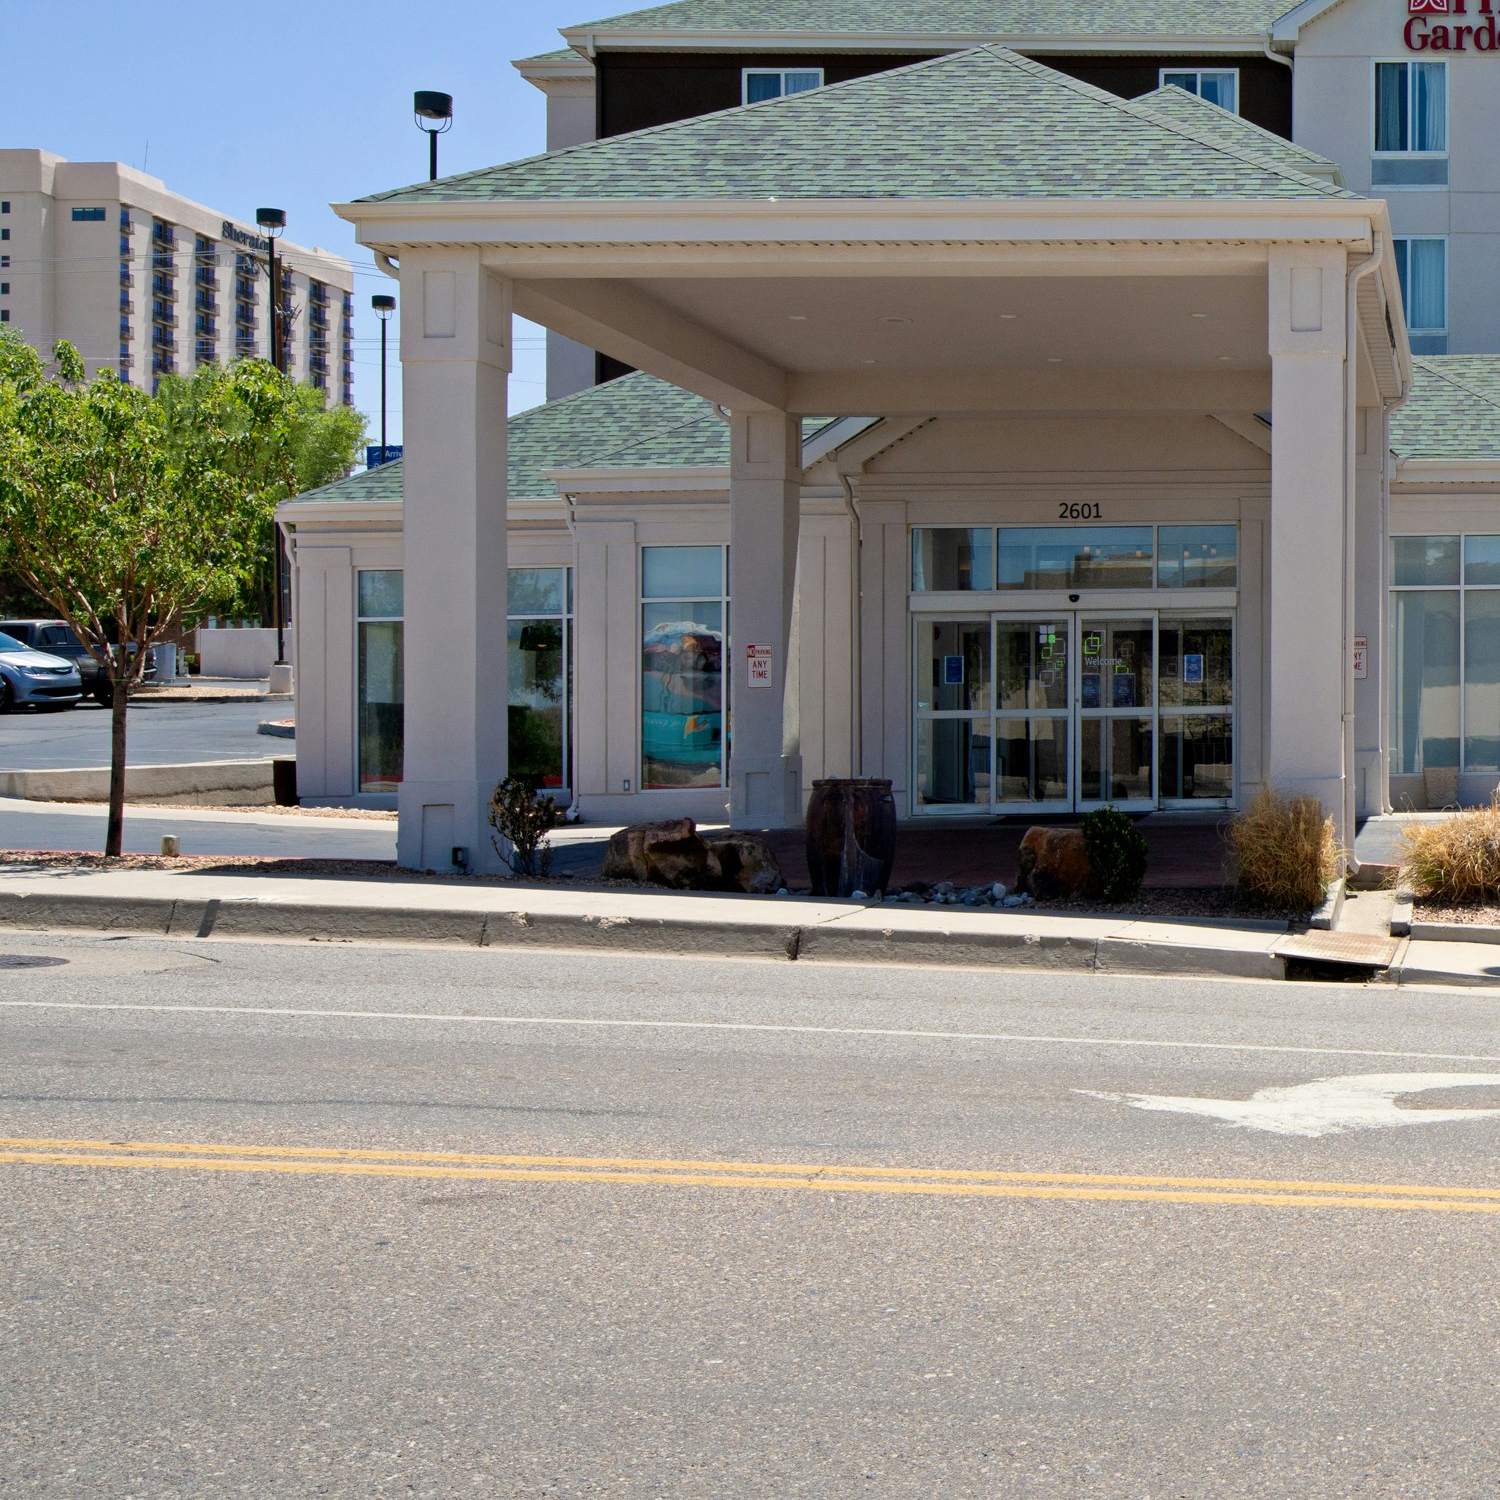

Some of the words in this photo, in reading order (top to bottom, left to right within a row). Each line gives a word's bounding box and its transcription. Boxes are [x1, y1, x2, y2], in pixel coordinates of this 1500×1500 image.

[385, 450, 403, 458] Arriv
[1059, 502, 1102, 519] 2601
[1354, 652, 1362, 660] NY
[752, 660, 767, 669] ANY
[1084, 657, 1122, 666] Welcome
[752, 670, 768, 679] TIME
